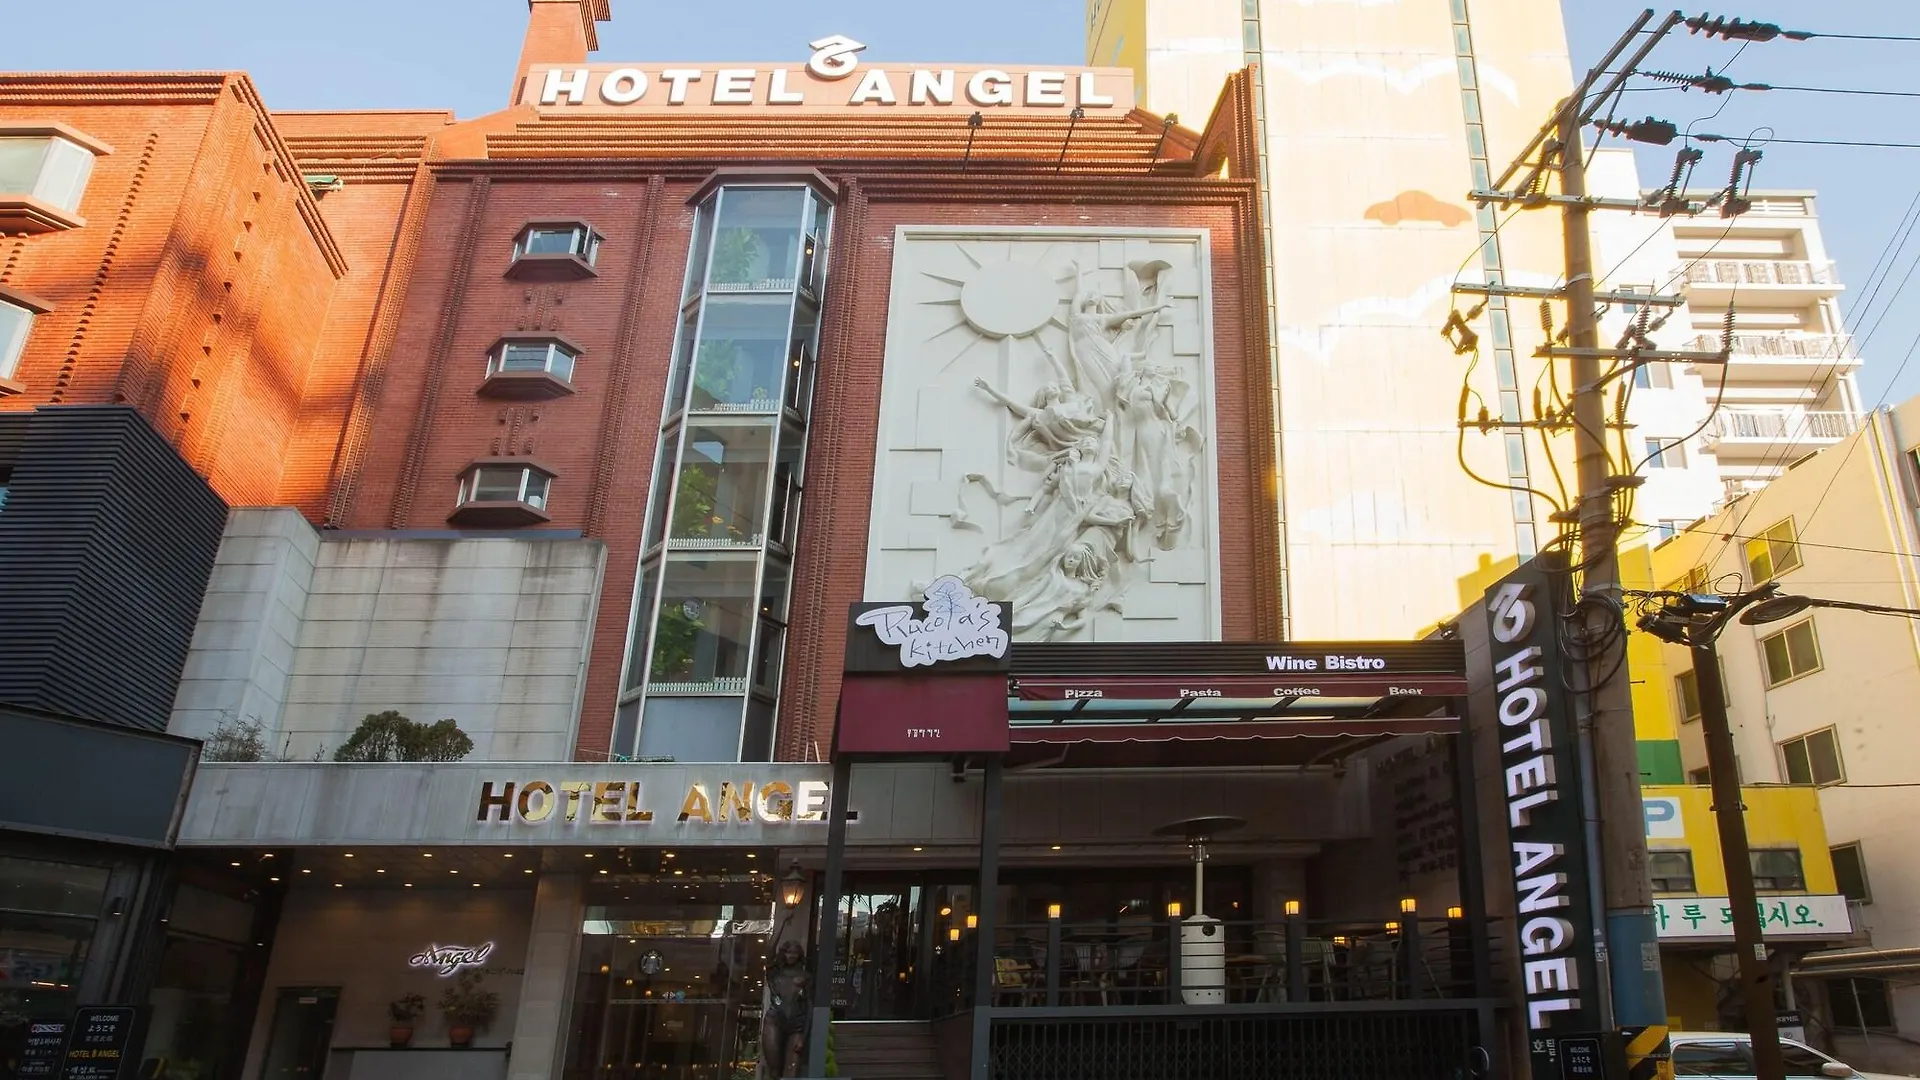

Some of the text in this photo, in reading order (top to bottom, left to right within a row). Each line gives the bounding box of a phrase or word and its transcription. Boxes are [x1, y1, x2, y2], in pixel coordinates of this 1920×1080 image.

[540, 68, 1114, 108] HOTEL ANGEL
[1266, 654, 1385, 670] Wine Bistro
[1064, 686, 1423, 699] Pizza Pasta Coffee Beer
[477, 779, 858, 823] HOTEL ANGE
[1642, 800, 1675, 836] P
[1495, 645, 1581, 1030] HOTEL ANGEL
[408, 942, 494, 977] Angel
[87, 1024, 116, 1033] ようこそ
[90, 1014, 120, 1022] WELCOME
[68, 1049, 90, 1058] HOTEL
